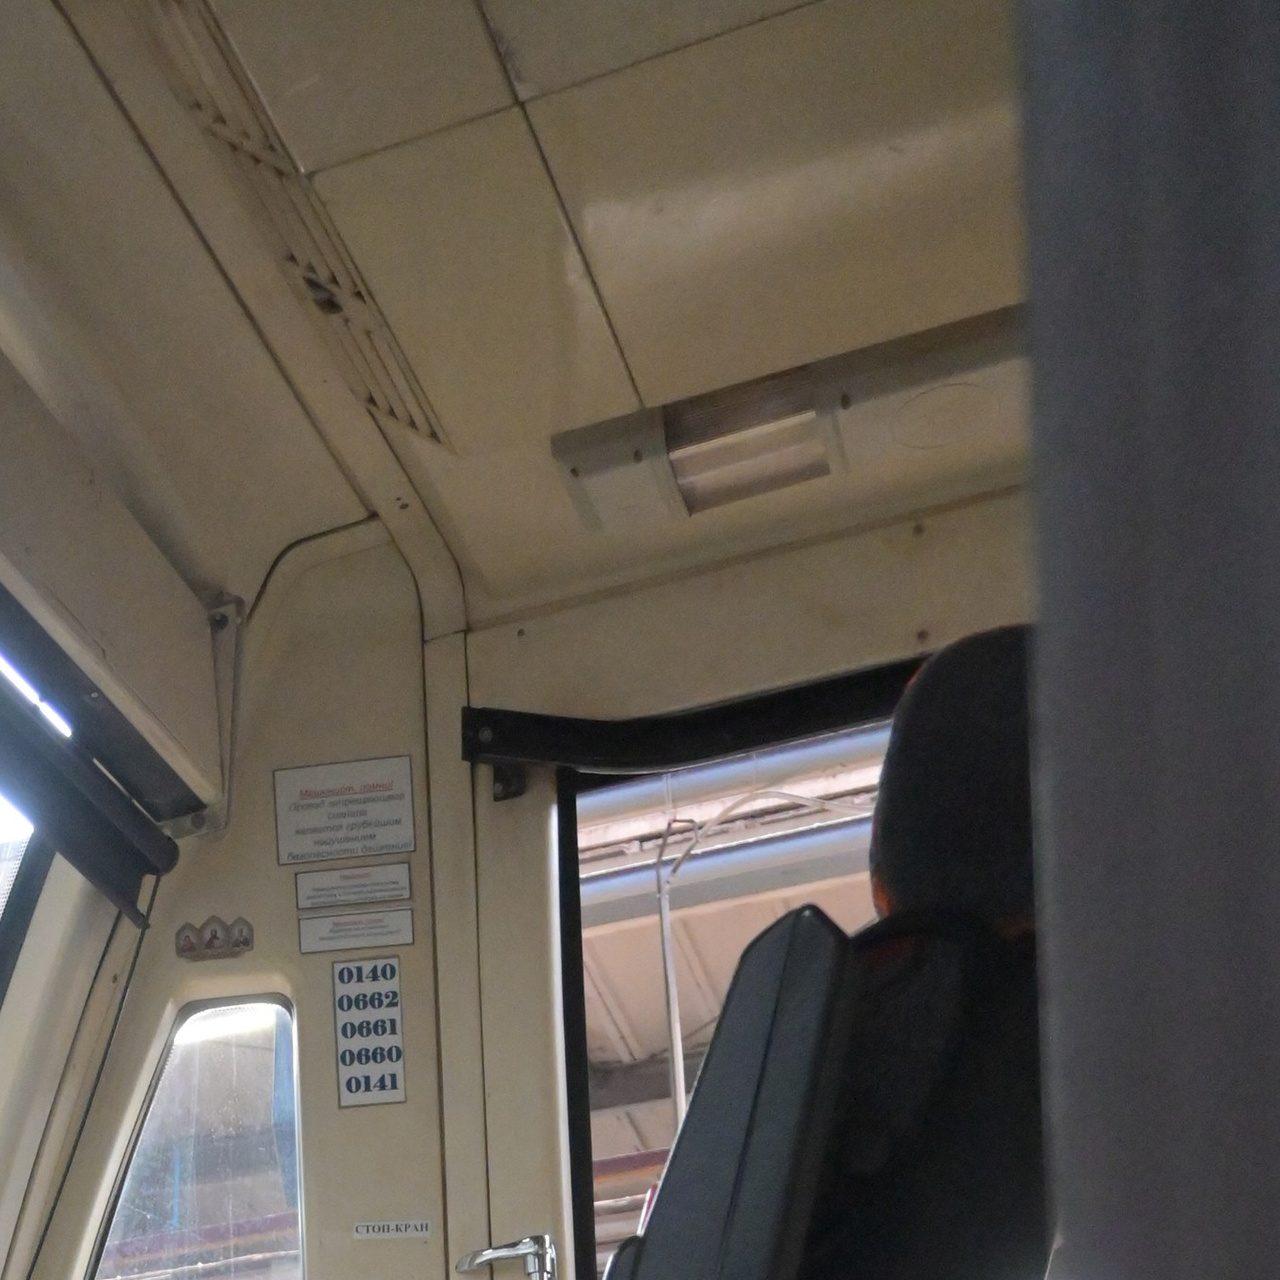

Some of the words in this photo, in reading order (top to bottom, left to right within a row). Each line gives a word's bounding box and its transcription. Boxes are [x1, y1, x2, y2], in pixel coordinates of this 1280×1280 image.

[337, 963, 397, 985] 0140
[337, 990, 400, 1013] 0662
[340, 1018, 398, 1040] 0661
[340, 1045, 403, 1067] 0660
[345, 1072, 400, 1095] 0141
[354, 1221, 430, 1236] СТОП-КРАН
